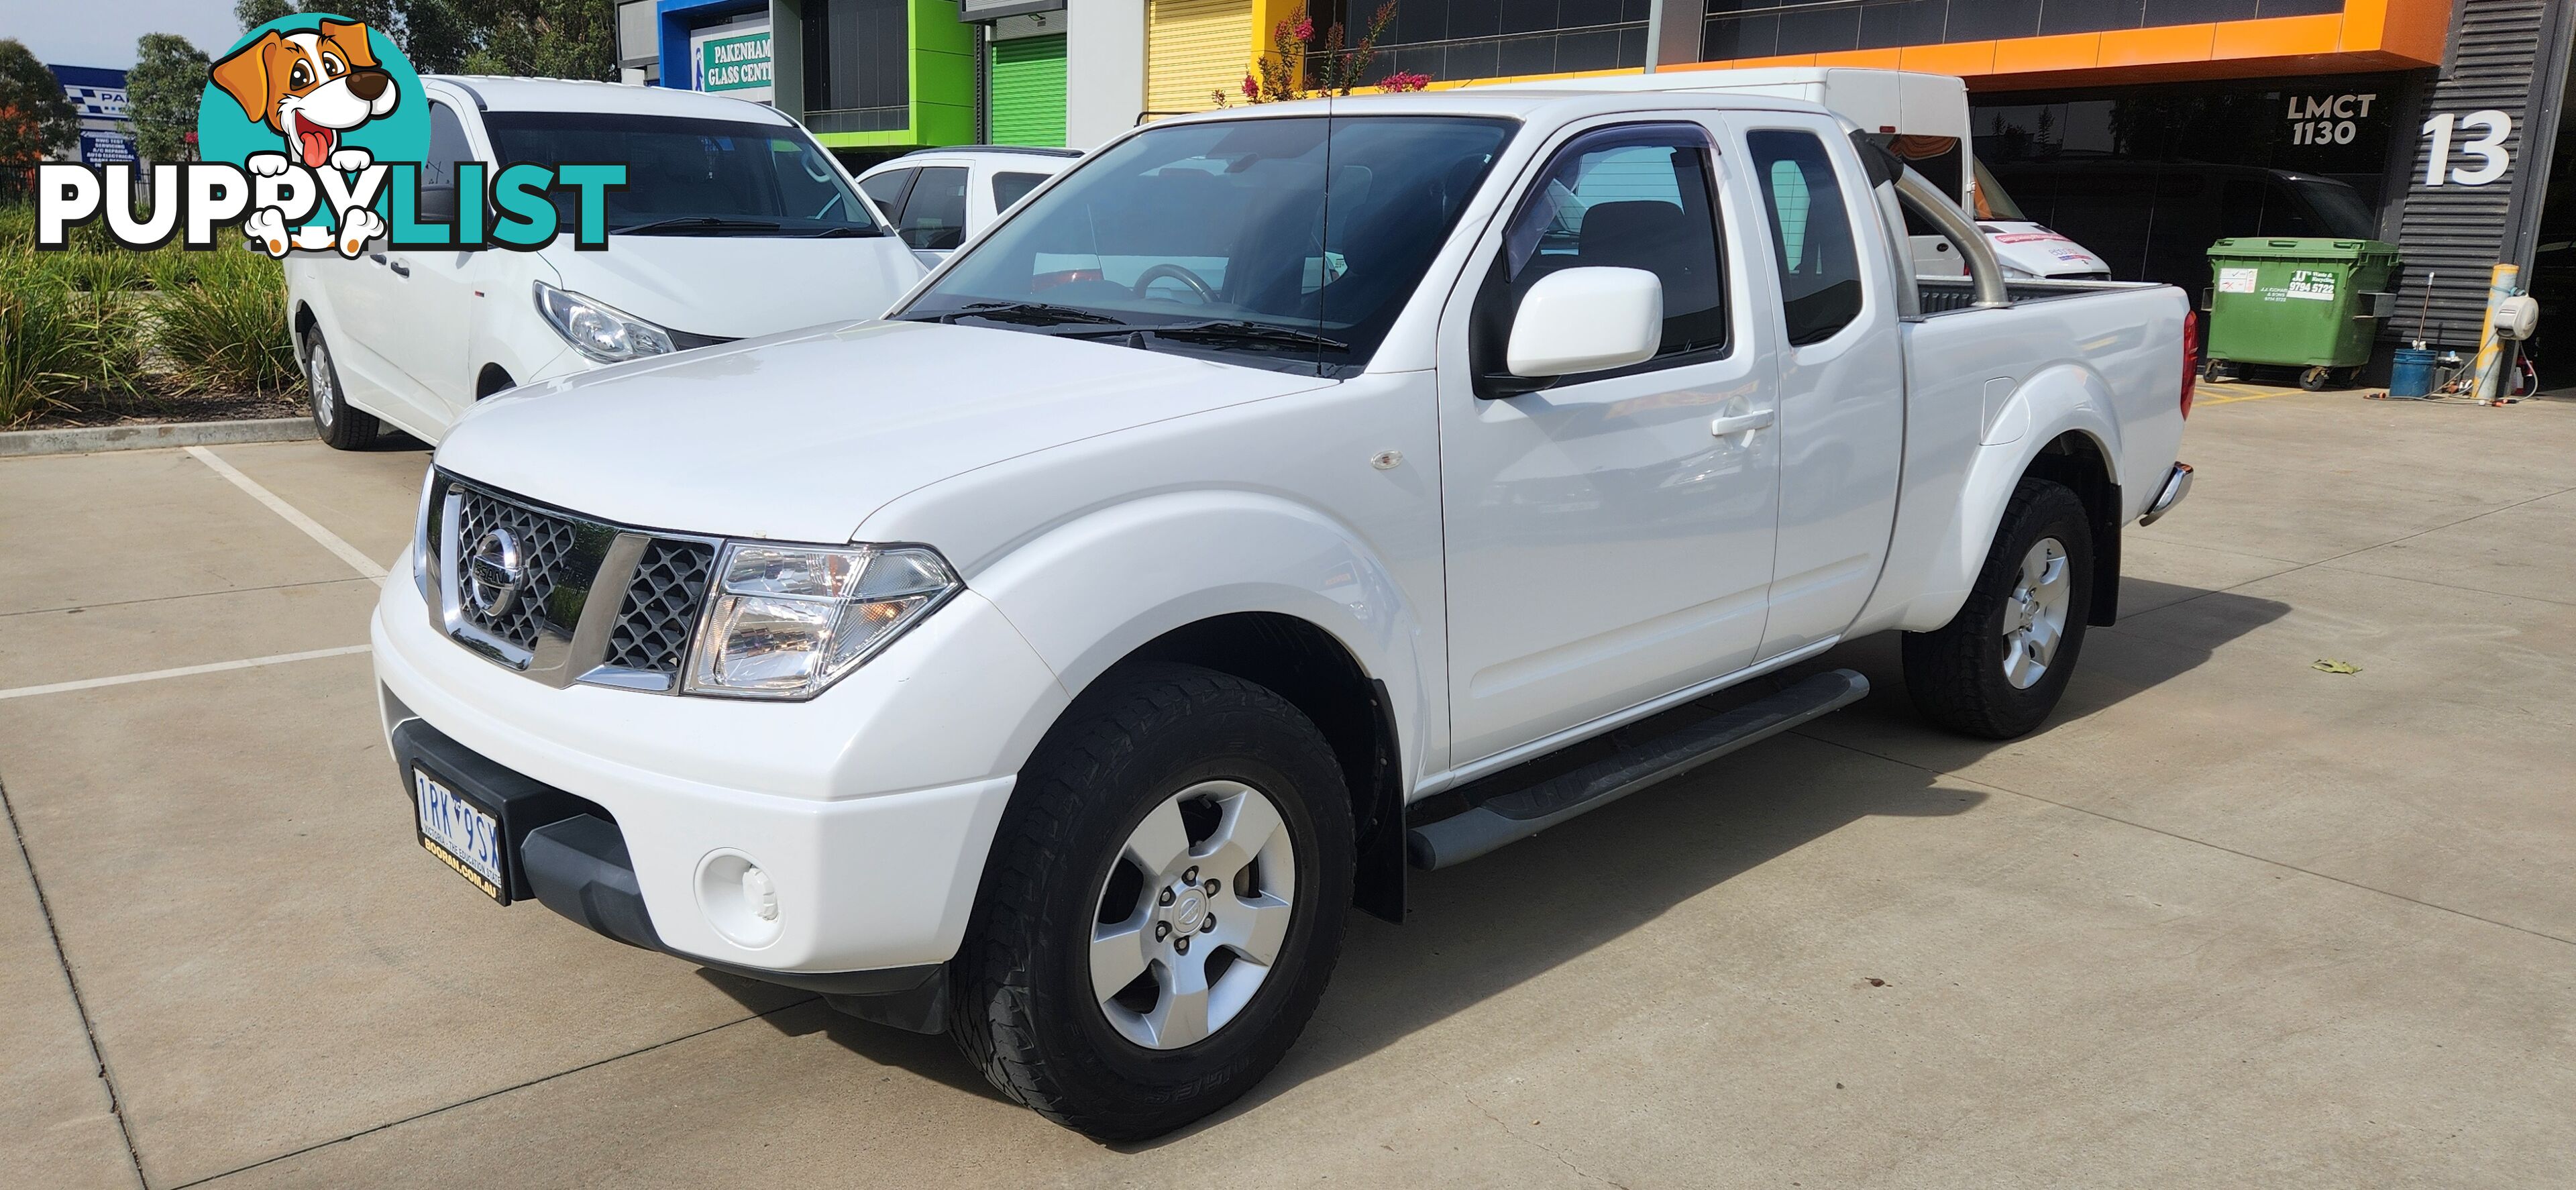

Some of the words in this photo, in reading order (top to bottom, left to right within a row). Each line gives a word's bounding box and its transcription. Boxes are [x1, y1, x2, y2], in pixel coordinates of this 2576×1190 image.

[714, 39, 771, 64] PAKENHAM
[708, 65, 739, 86] GLASS
[101, 93, 128, 103] PA
[2287, 94, 2376, 119] LMCT
[2293, 121, 2357, 145] 1130
[2422, 109, 2512, 187] 13
[2289, 281, 2311, 292] 9794
[2311, 283, 2334, 294] 5722
[419, 777, 453, 839] 1RK
[464, 808, 500, 871] 9SX
[424, 825, 445, 846] VICTORIA
[449, 841, 459, 855] THE
[459, 849, 486, 874] EDUCATION
[486, 867, 501, 885] STATE
[424, 837, 496, 899] BOORAN.COM.AU
